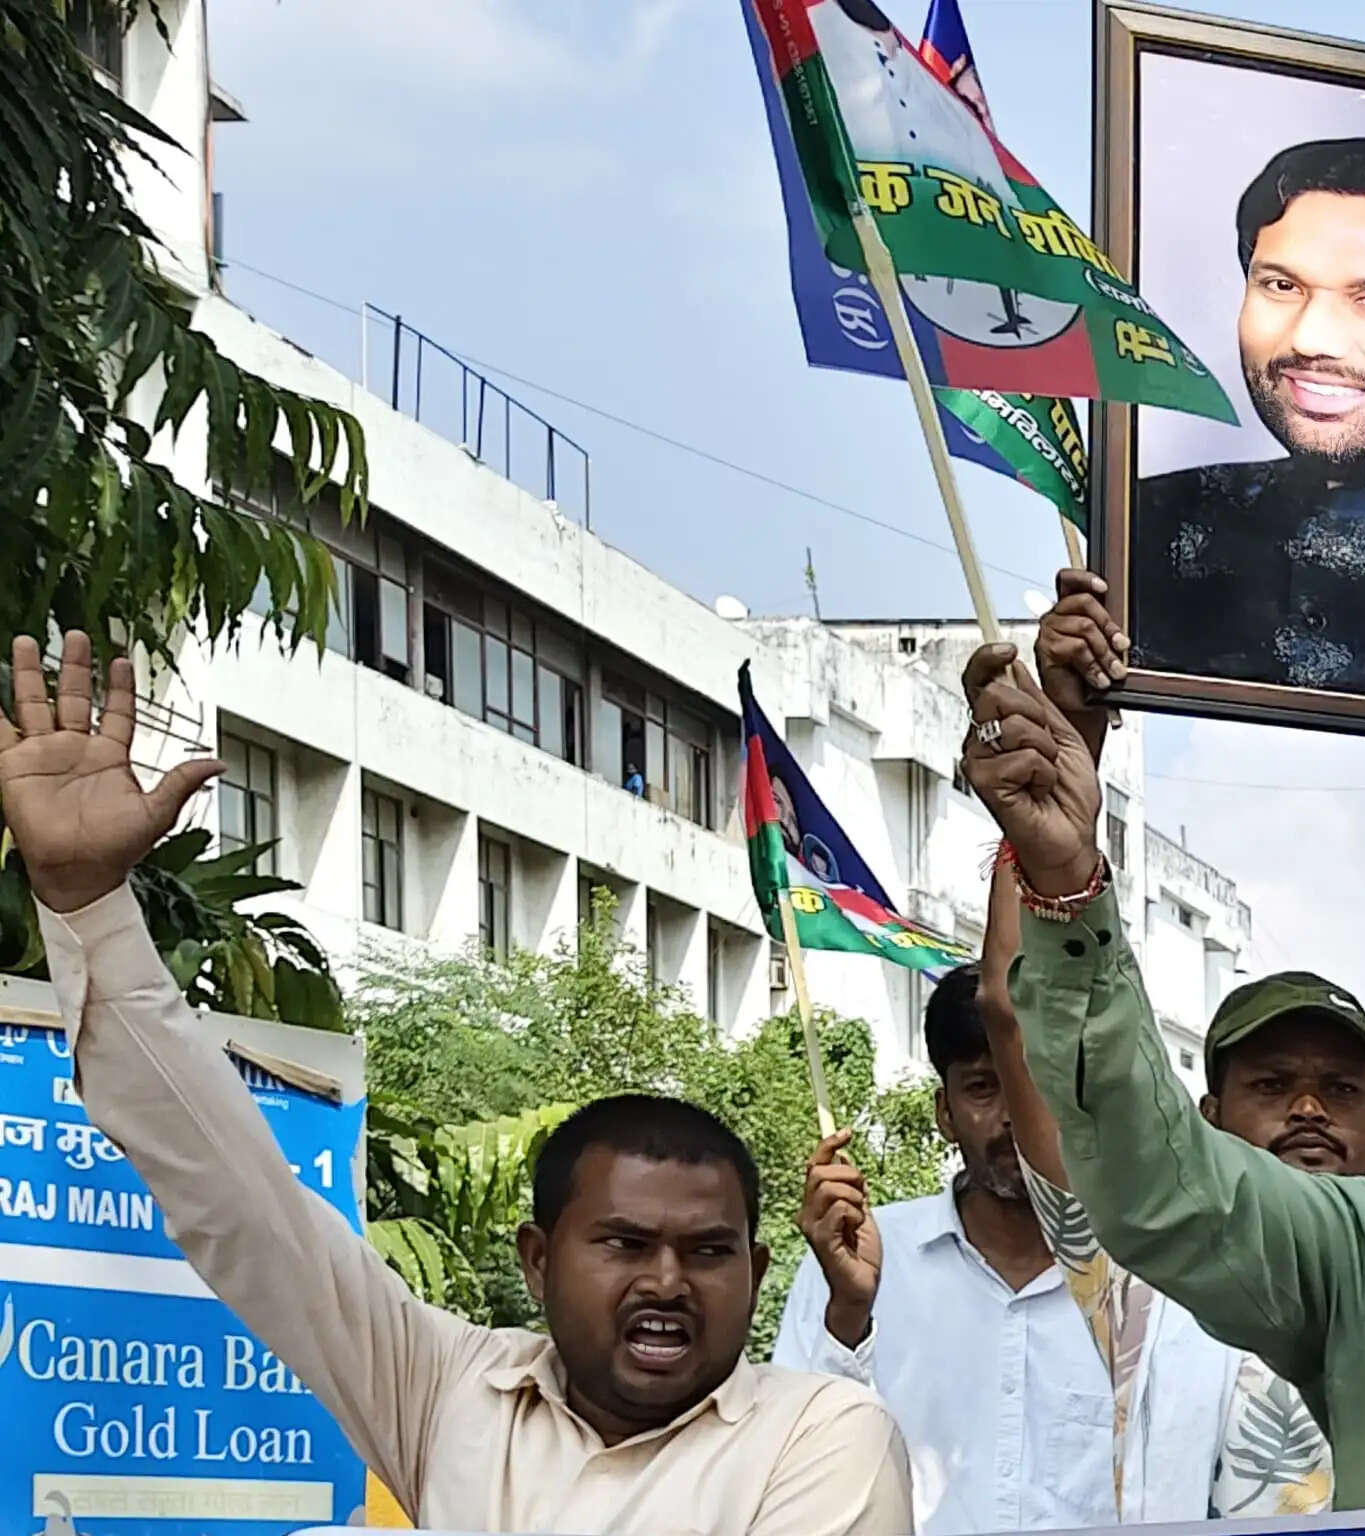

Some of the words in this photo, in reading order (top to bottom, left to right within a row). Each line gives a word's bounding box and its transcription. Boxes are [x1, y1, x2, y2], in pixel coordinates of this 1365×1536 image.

[856, 162, 913, 214] क
[923, 165, 1014, 241] जन
[313, 1149, 333, 1188] 1
[68, 1185, 153, 1231] MAIN
[17, 1319, 206, 1389] Canara
[223, 1334, 314, 1395] Ba
[54, 1401, 179, 1460] Gold
[194, 1408, 314, 1465] Loan
